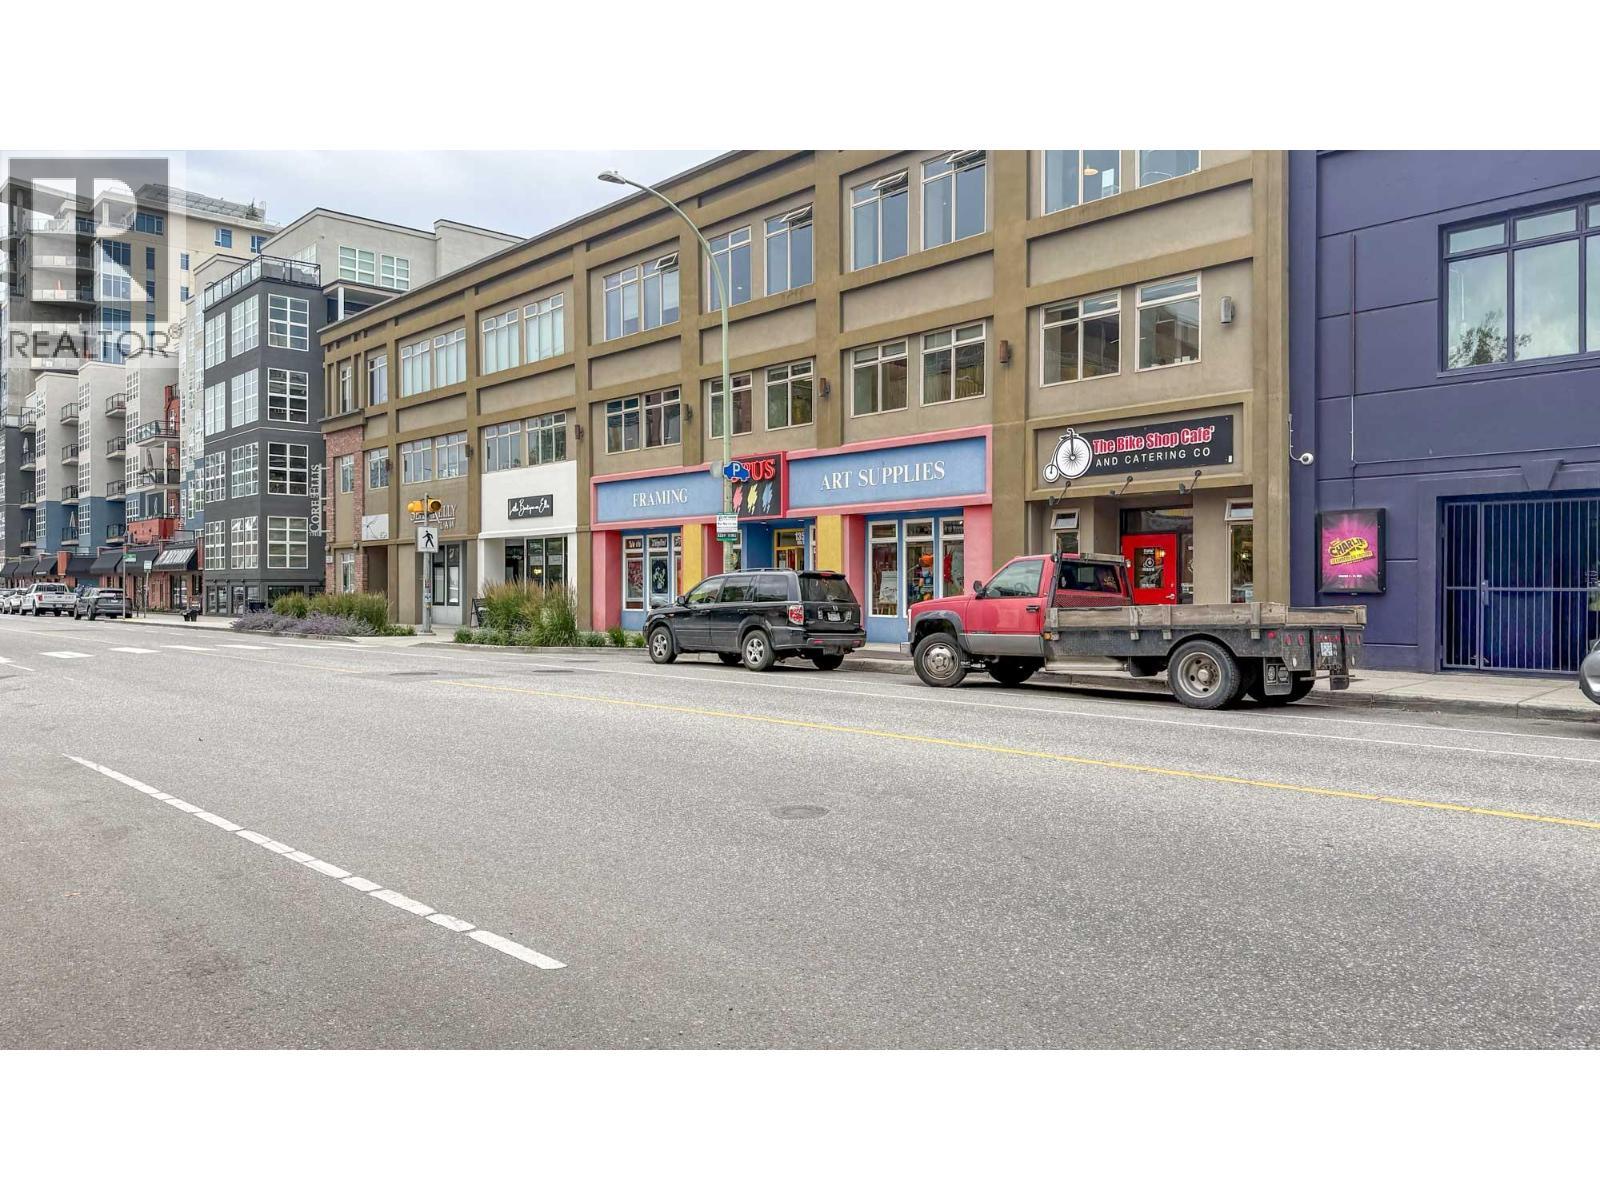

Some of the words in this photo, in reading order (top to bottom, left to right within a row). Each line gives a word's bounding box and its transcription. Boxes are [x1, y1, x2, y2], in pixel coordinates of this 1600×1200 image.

[1093, 438, 1115, 455] The
[1116, 435, 1145, 452] Bike
[1146, 431, 1179, 449] Shop
[1095, 456, 1118, 468] AND
[1124, 449, 1187, 465] CATERING
[1193, 447, 1211, 457] CO
[732, 463, 741, 477] P
[820, 471, 852, 491] ART
[858, 460, 945, 487] SUPPLIES
[632, 487, 689, 508] FRAMING
